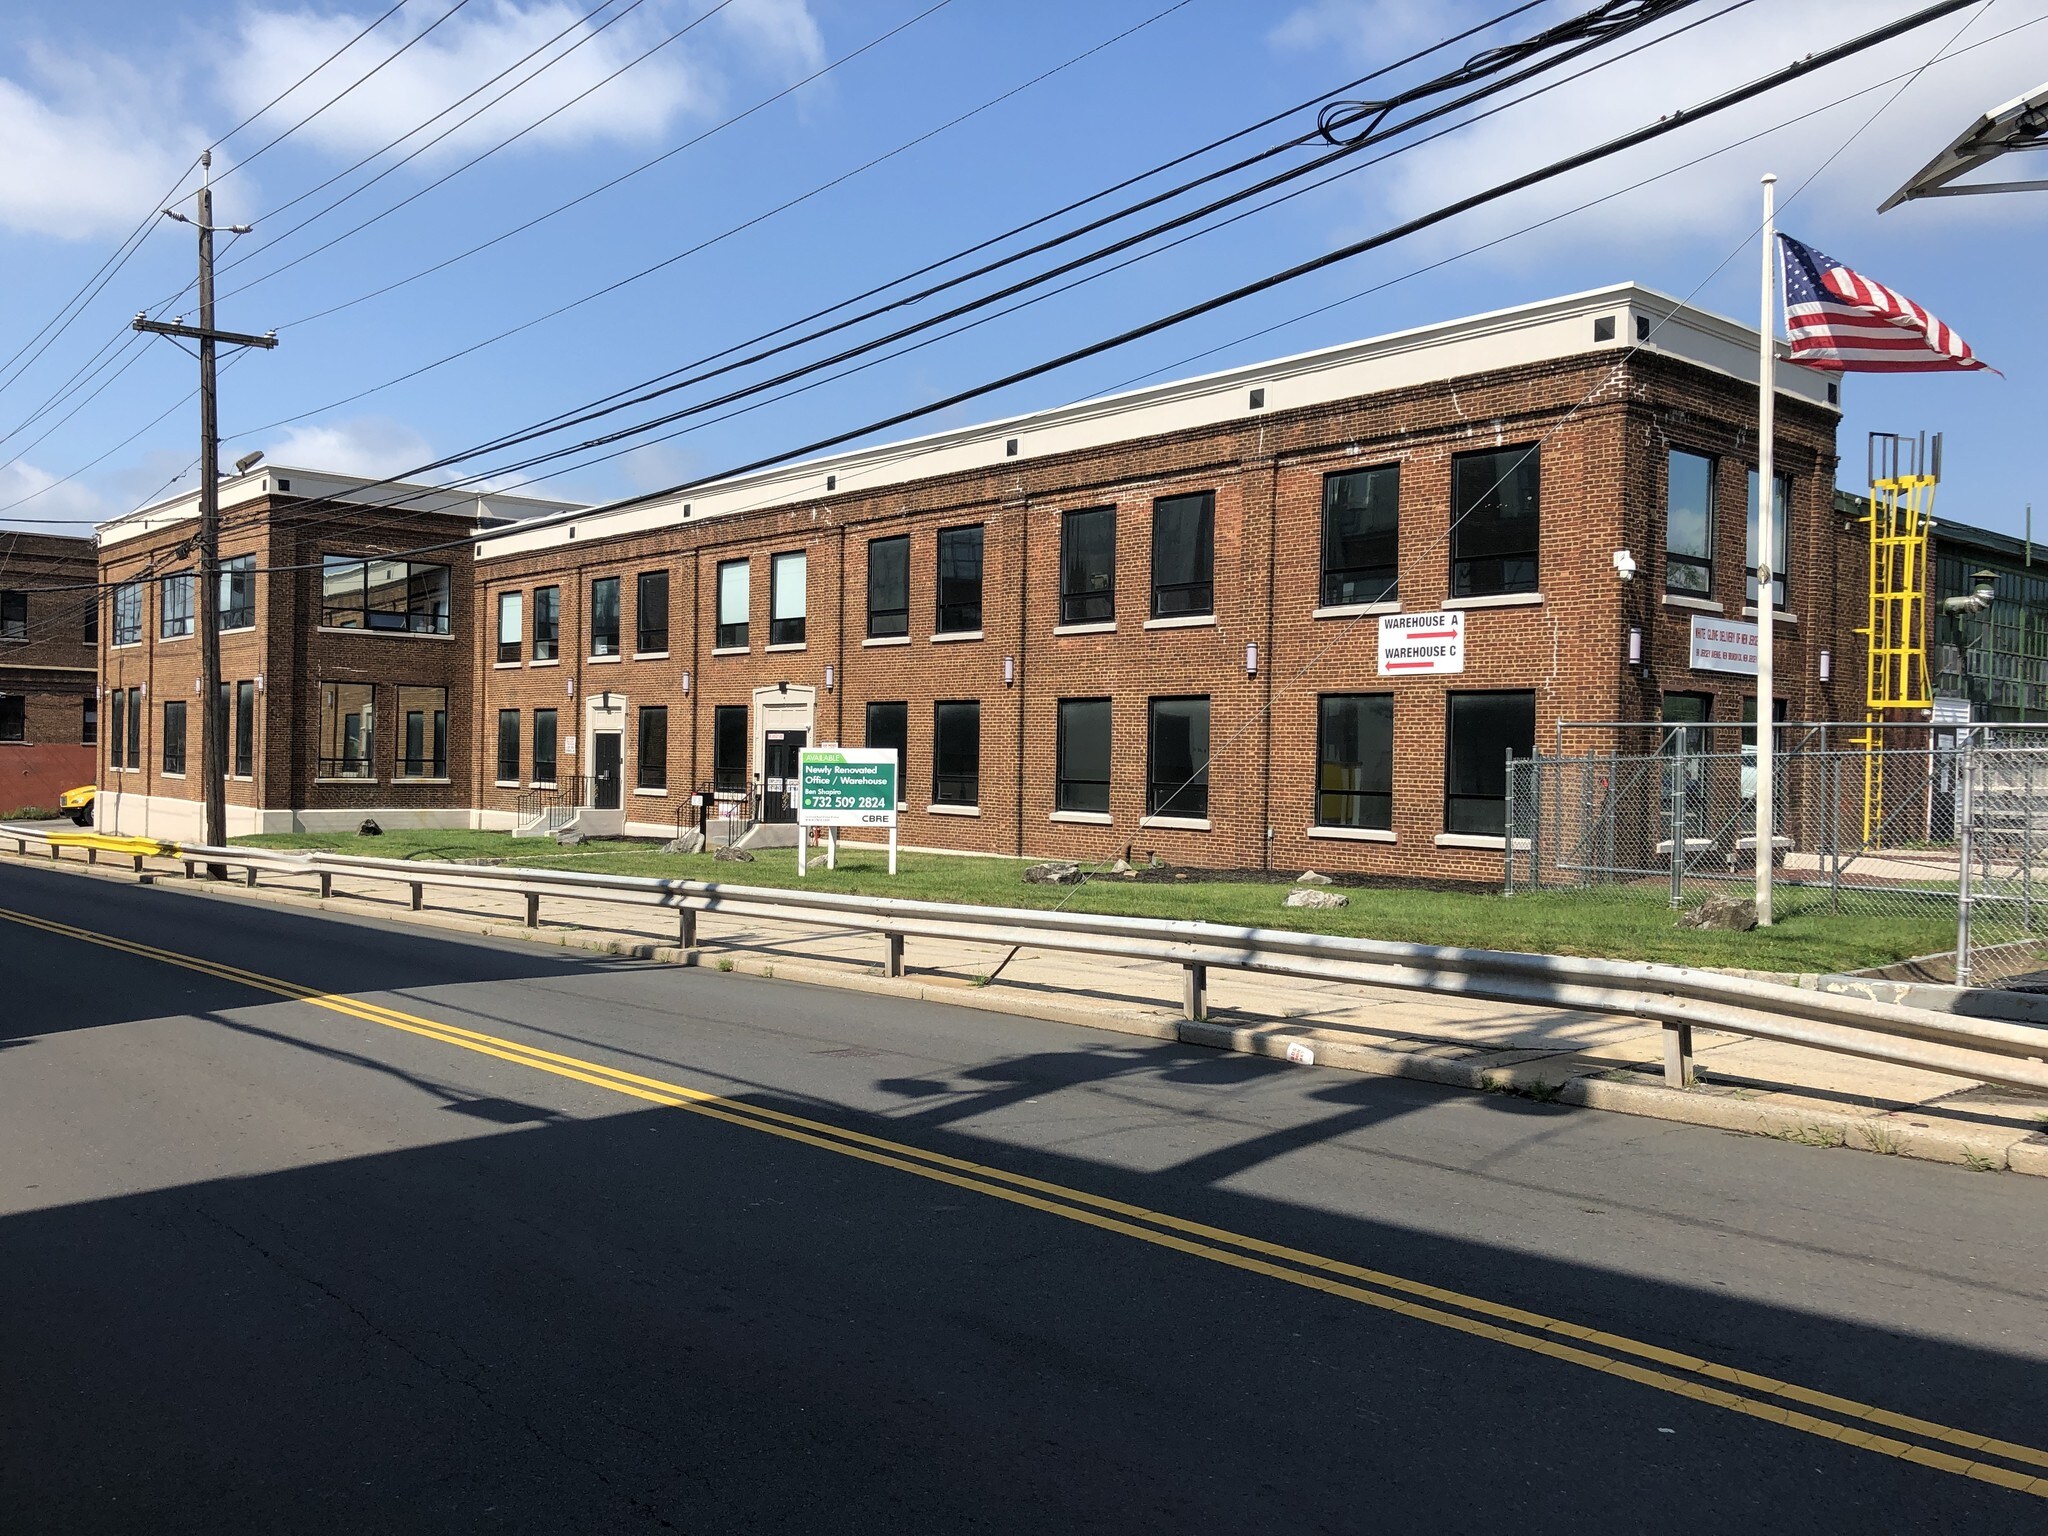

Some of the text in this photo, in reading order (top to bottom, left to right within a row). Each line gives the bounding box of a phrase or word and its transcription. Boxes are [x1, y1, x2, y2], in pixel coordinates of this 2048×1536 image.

[1384, 614, 1458, 629] WAREHOUSE A
[1385, 645, 1456, 659] WAREHOUSE C
[806, 754, 840, 762] AVAILABLE
[805, 765, 878, 775] Newly Renovated
[805, 776, 888, 786] Office / Warehouse
[817, 788, 842, 797] Shapiro
[812, 796, 886, 808] 732 509 2824
[861, 814, 889, 823] CBRE
